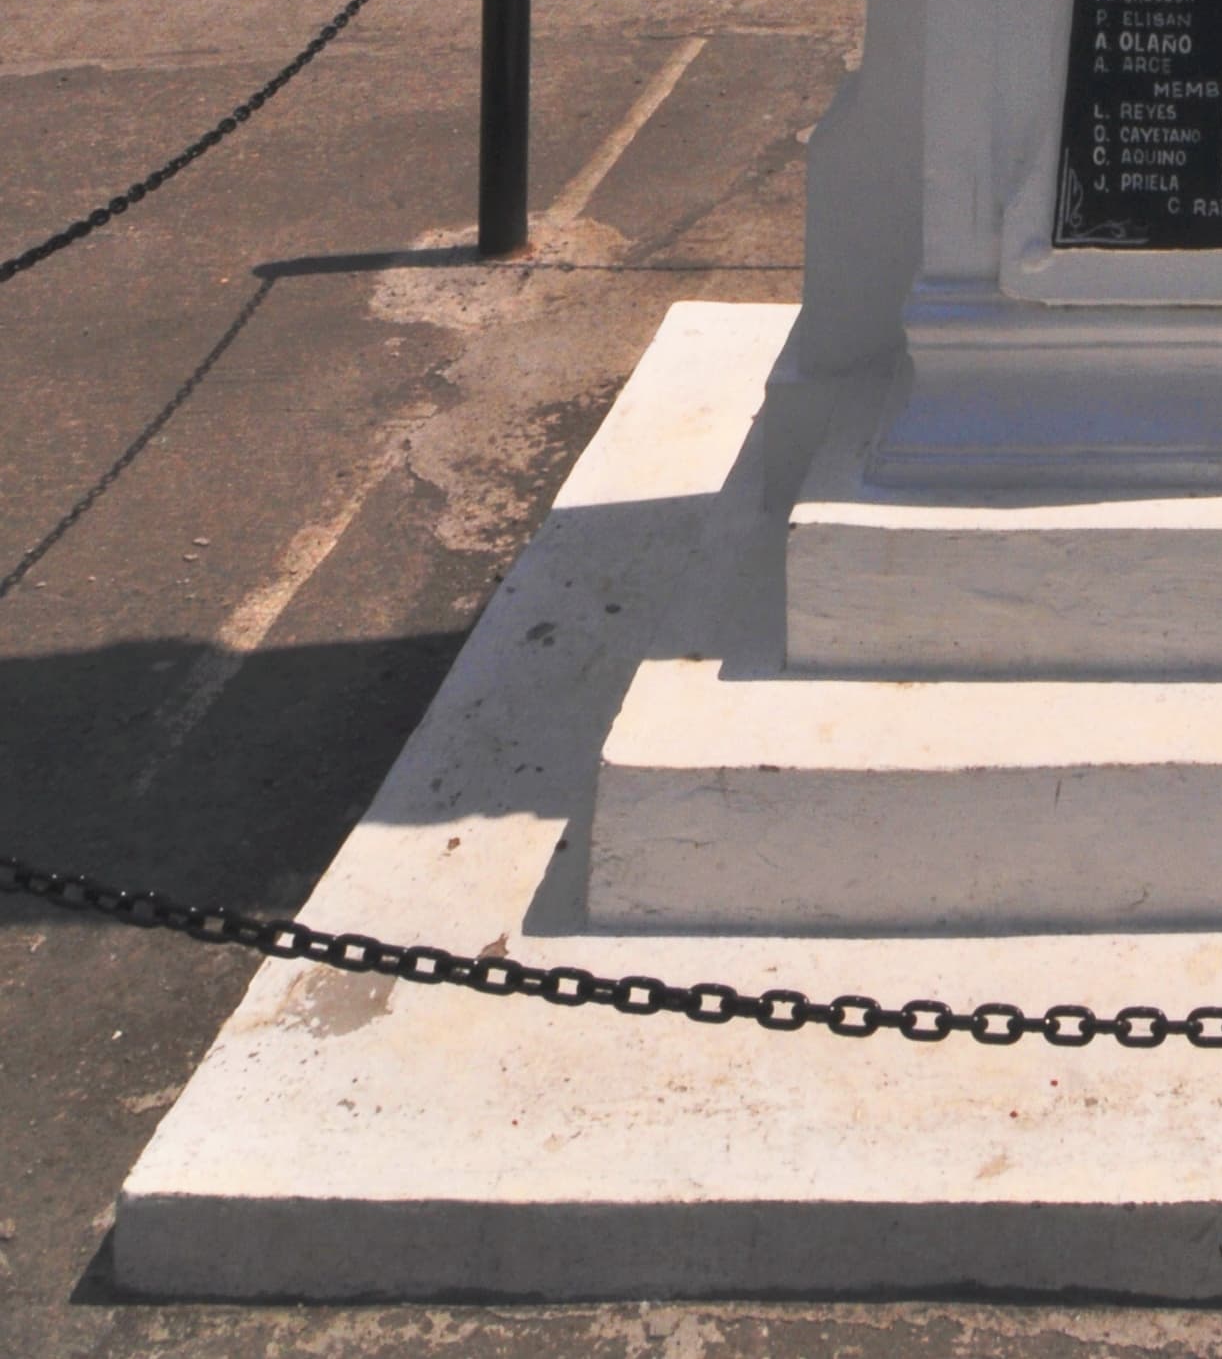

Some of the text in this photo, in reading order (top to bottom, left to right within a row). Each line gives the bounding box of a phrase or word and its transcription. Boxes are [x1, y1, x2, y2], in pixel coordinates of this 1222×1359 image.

[1119, 31, 1192, 54] OLAÑO
[1122, 57, 1171, 73] ARCE
[1094, 103, 1176, 120] L. REYES
[1120, 128, 1201, 143] CAYETANO
[1093, 147, 1186, 165] C. AQUINO
[1094, 174, 1179, 193] J. PRIELA
